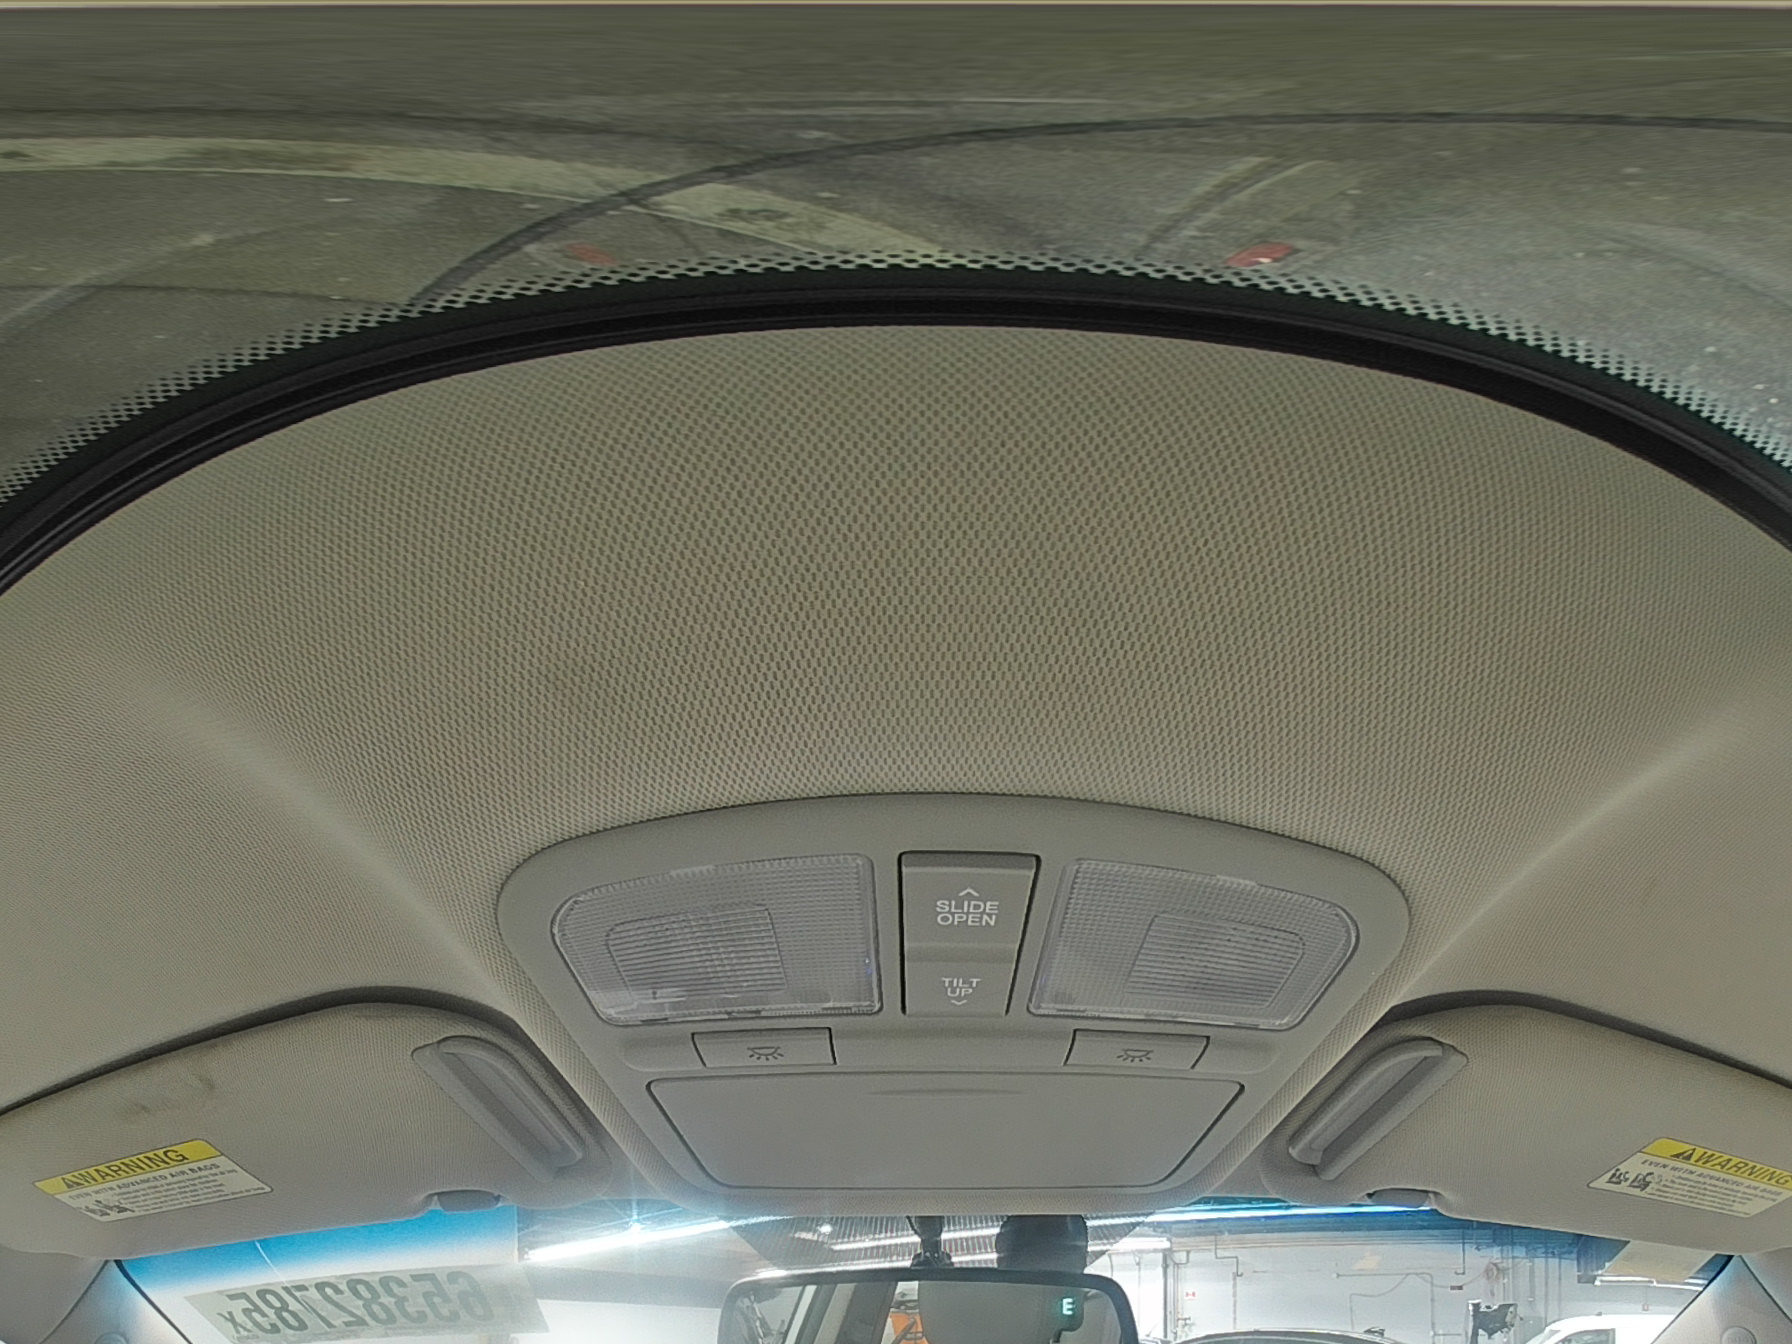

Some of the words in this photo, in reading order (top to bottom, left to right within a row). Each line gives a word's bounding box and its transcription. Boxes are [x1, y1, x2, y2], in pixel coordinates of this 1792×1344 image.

[936, 900, 999, 913] SLIDE
[937, 914, 996, 926] OPEN
[941, 978, 982, 988] TILT
[947, 987, 973, 997] UP
[74, 1149, 190, 1184] WARNING
[1062, 1298, 1073, 1315] E
